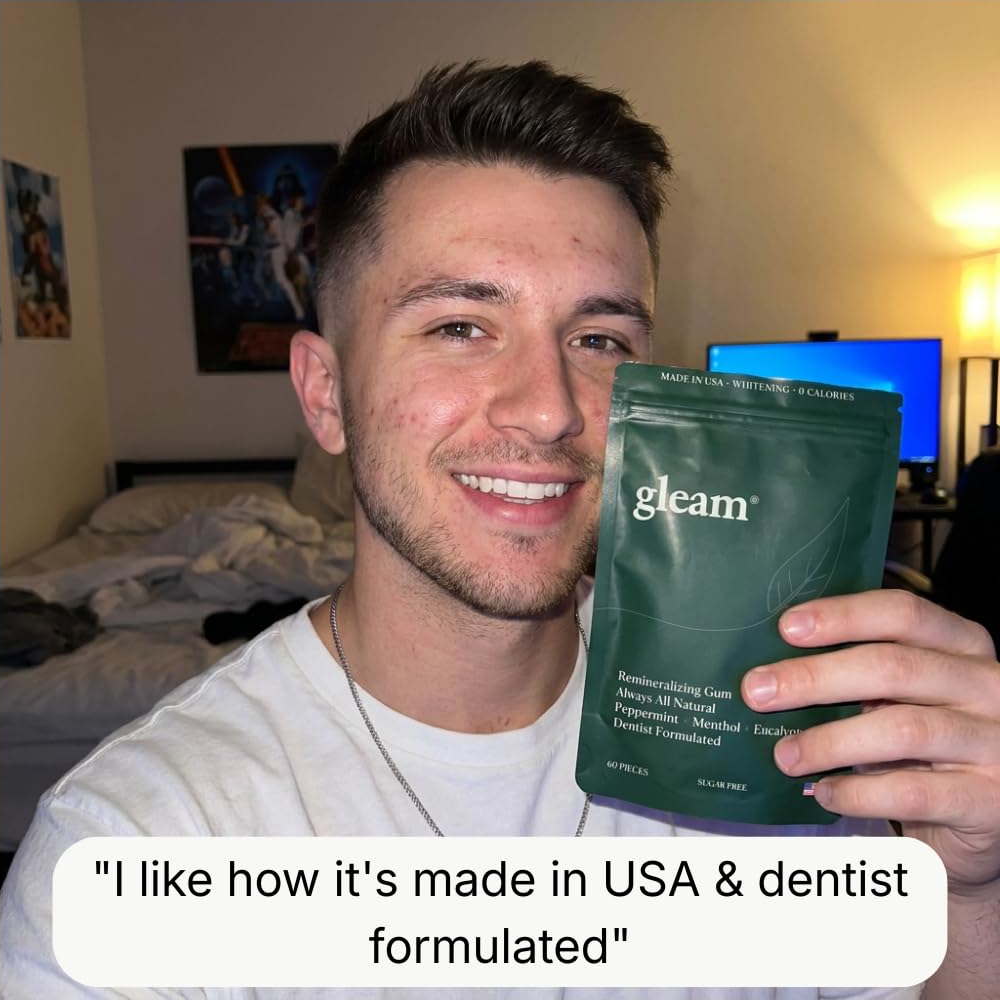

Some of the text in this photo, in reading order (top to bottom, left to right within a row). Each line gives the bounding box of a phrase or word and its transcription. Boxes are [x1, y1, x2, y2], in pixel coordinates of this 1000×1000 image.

[660, 372, 689, 383] MADE
[691, 374, 702, 384] IN
[705, 377, 723, 387] USA
[732, 379, 790, 394] WHITENING
[806, 388, 855, 401] CALORIES
[618, 670, 732, 699] Remineralizing Gum
[616, 687, 716, 714] Always All Natural
[613, 717, 721, 746] Dentist Formulated
[614, 702, 679, 724] Peppermint
[692, 716, 741, 733] Menthol
[606, 760, 649, 776] 60 PIECES
[697, 778, 748, 792] SUGAR FREE
